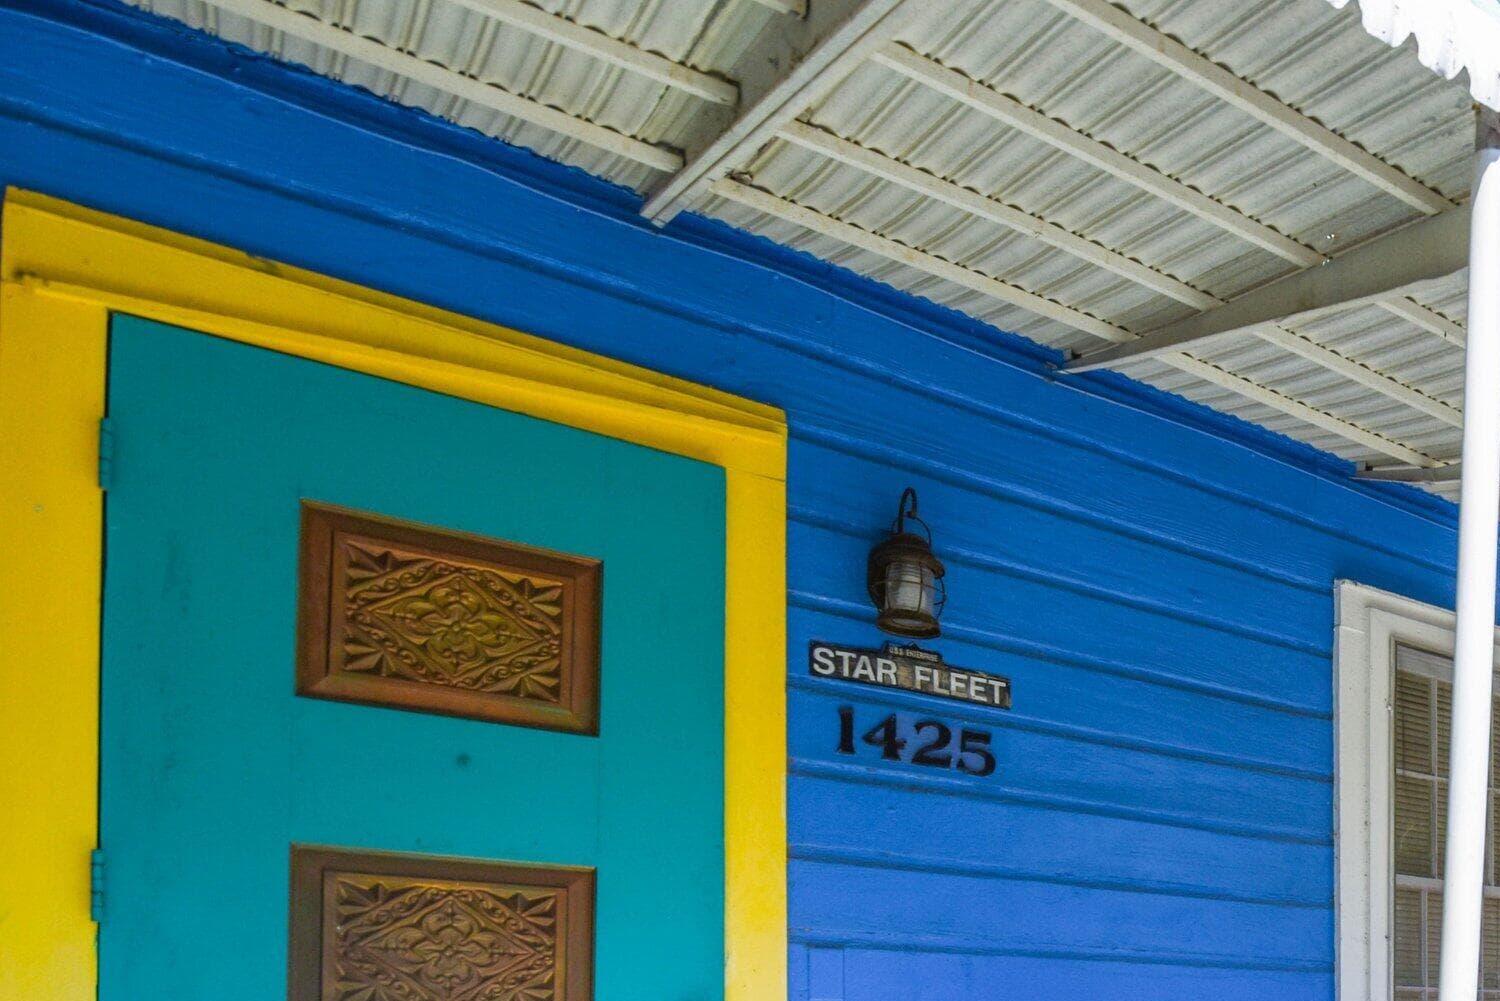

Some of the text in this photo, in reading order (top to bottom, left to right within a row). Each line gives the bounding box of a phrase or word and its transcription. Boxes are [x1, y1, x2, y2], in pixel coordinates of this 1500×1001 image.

[813, 647, 1007, 705] STAR FLEET
[836, 706, 996, 777] 1425
